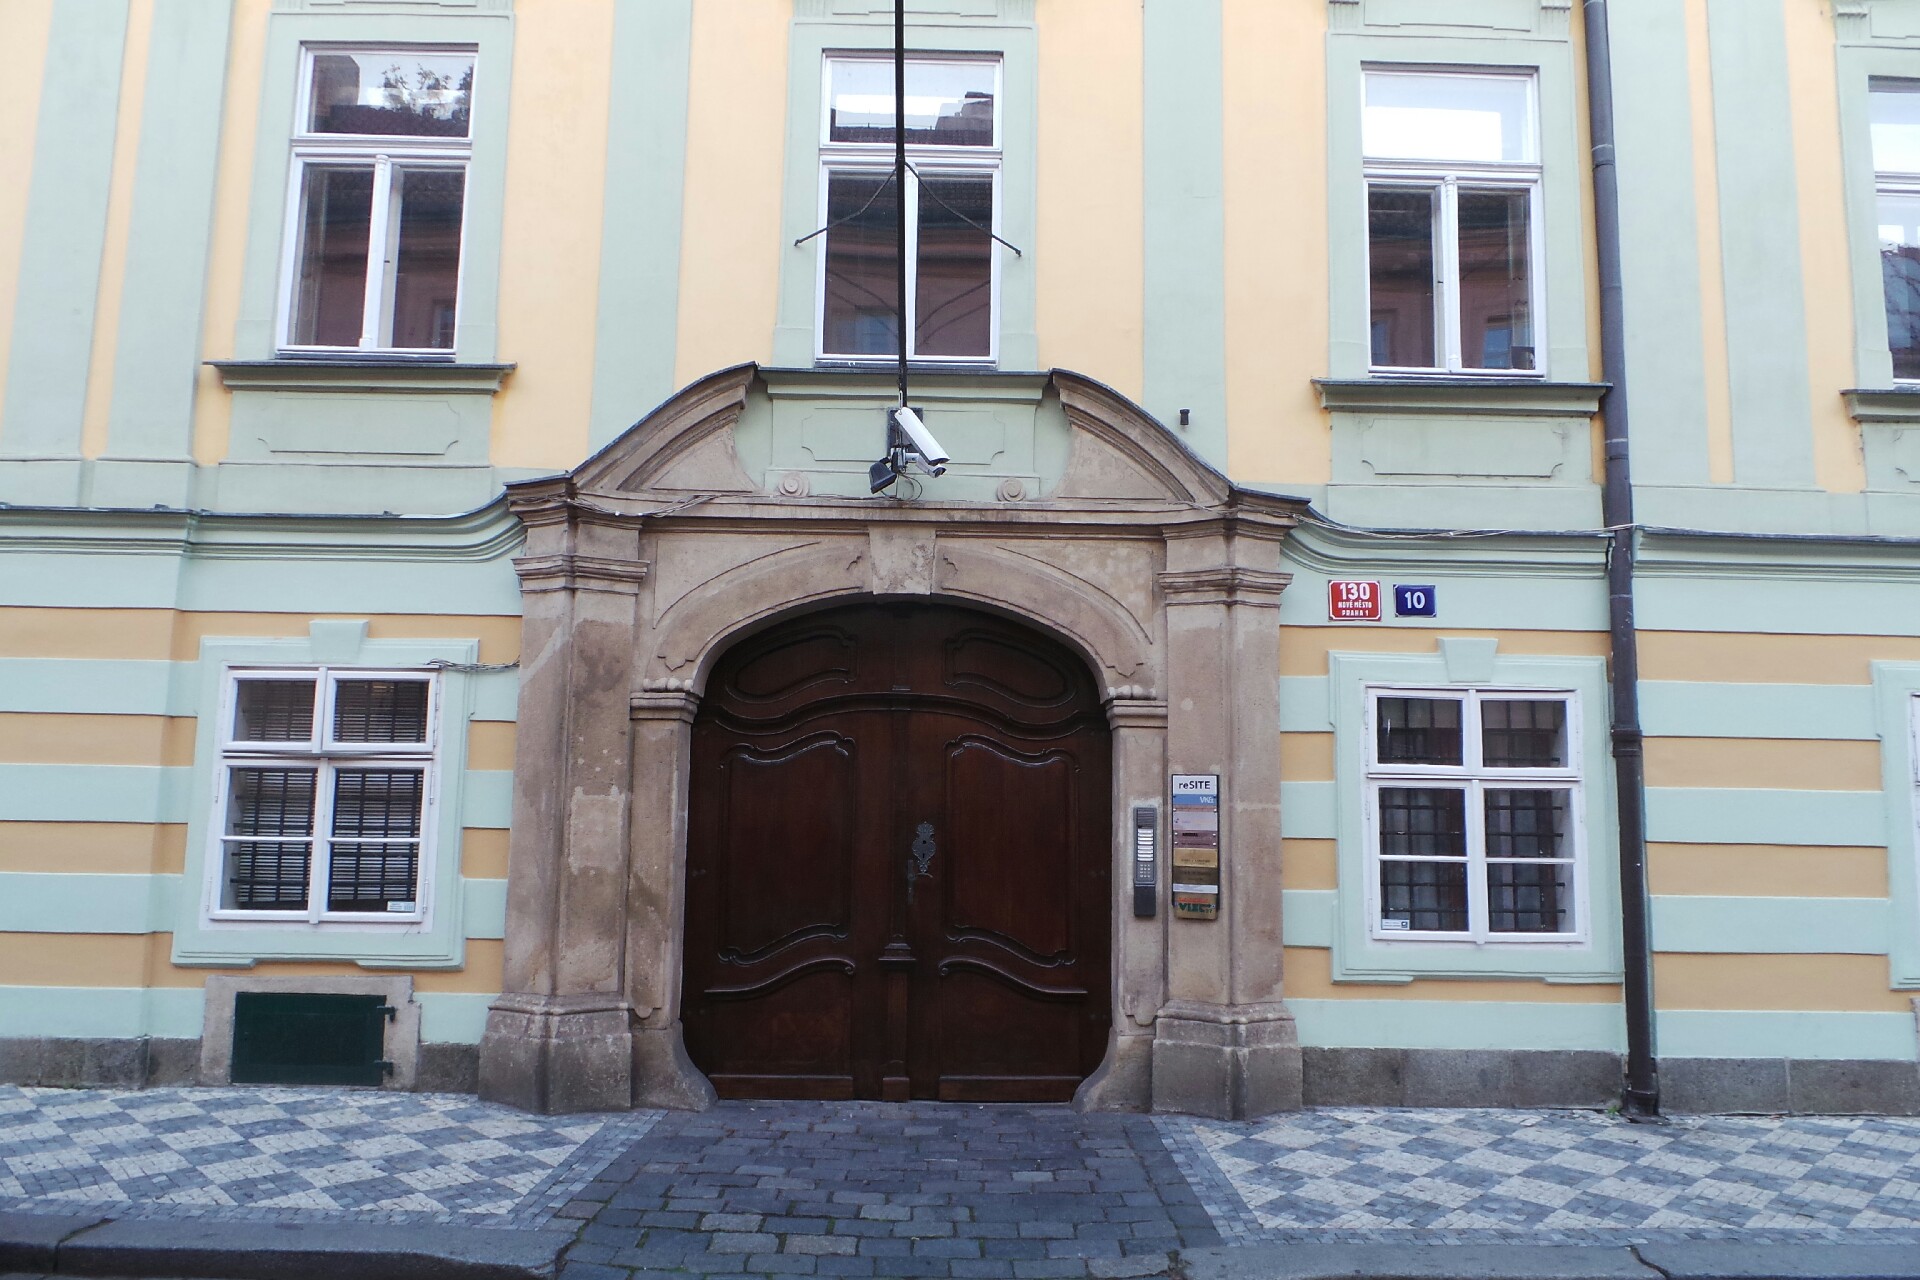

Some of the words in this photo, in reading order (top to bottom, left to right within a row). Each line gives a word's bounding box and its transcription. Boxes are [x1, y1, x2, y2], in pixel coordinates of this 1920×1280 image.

[1340, 583, 1370, 600] 130
[1338, 599, 1354, 609] NOVÉ
[1354, 599, 1372, 609] MĚSTO
[1404, 591, 1426, 609] 10
[1341, 609, 1364, 617] PRAHA
[1178, 780, 1211, 790] reSITE
